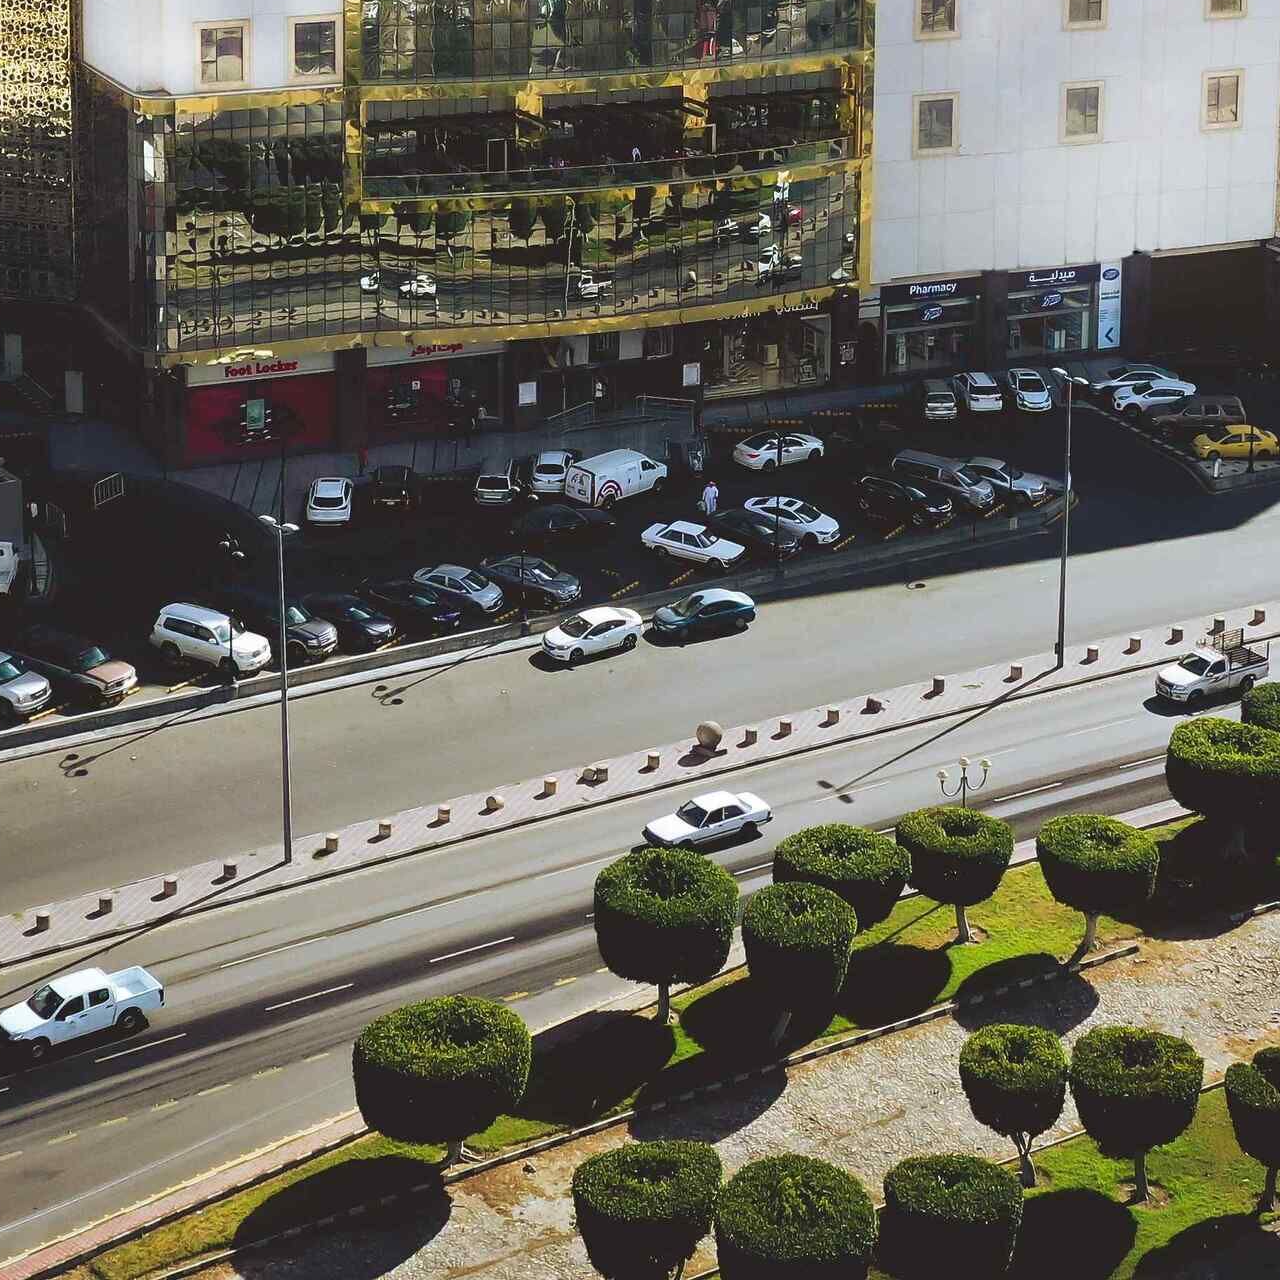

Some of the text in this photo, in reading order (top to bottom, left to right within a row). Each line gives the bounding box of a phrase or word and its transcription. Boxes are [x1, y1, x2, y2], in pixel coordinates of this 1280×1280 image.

[910, 282, 957, 296] Pharmacy
[225, 359, 298, 378] Foot Locker
